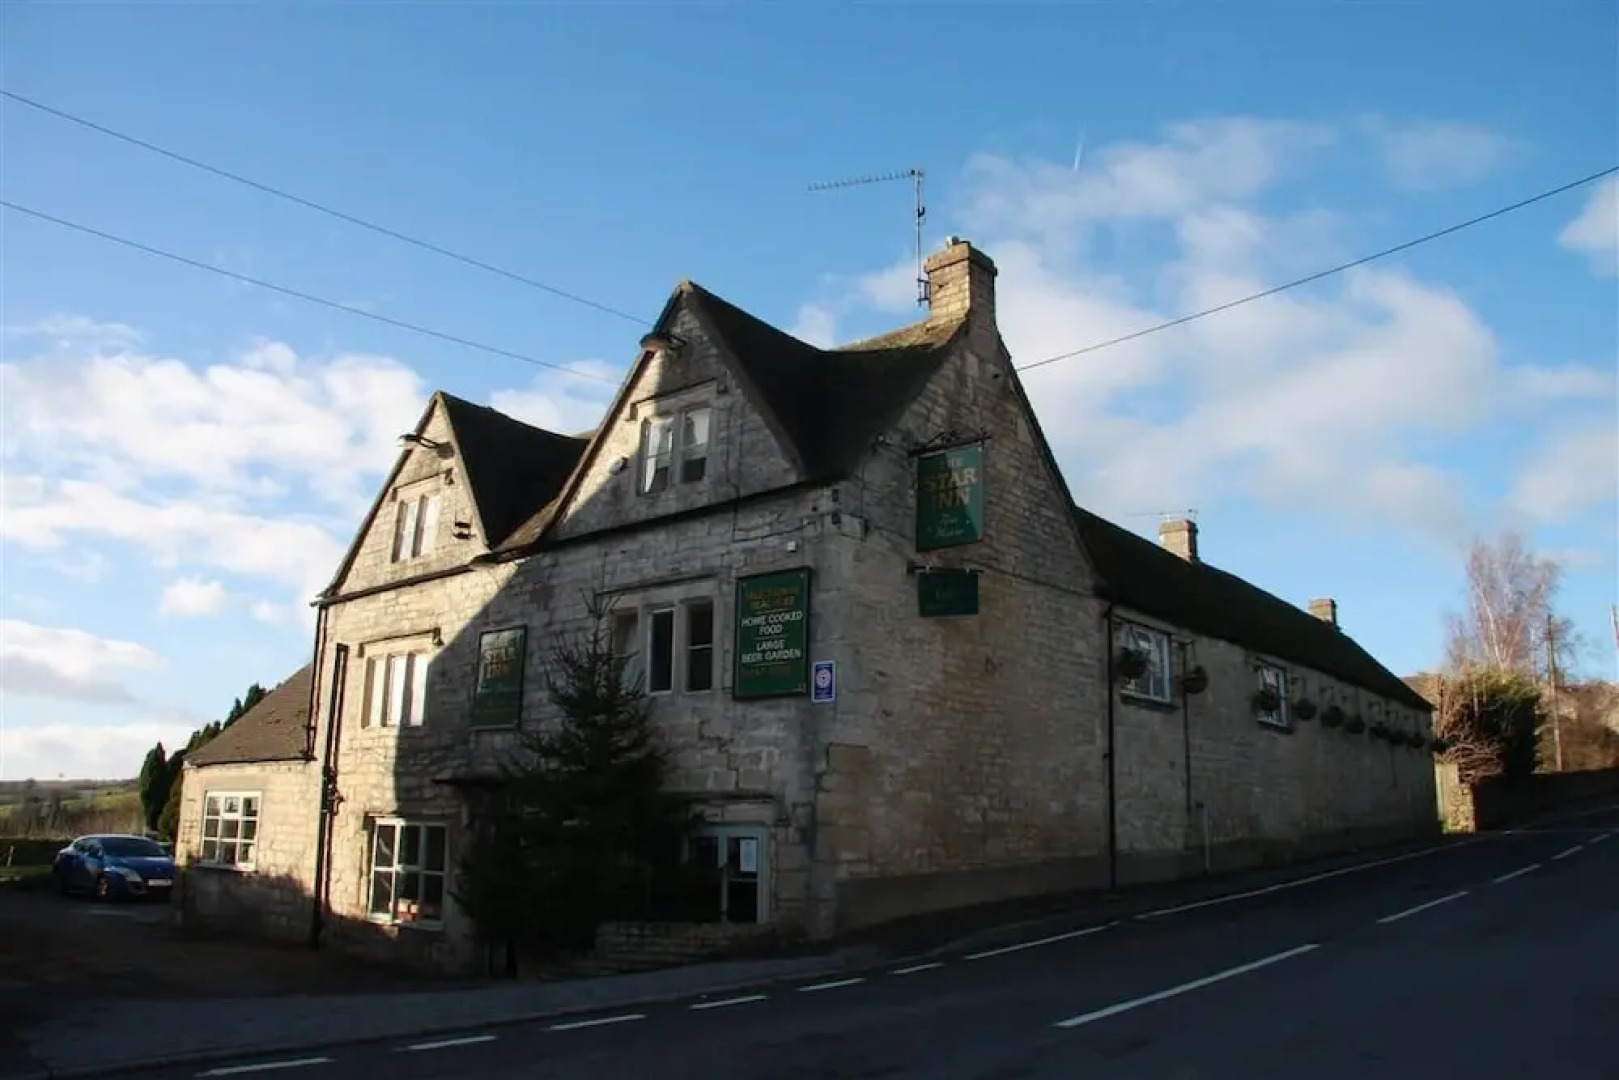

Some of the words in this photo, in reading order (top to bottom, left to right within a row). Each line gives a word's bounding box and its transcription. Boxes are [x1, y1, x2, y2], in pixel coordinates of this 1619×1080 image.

[921, 466, 978, 492] STAR
[931, 486, 970, 511] INN
[741, 615, 767, 628] HOME
[768, 610, 803, 622] COOKED
[758, 624, 783, 635] FOOD
[756, 639, 785, 652] LARGE
[741, 652, 763, 663] BEER
[764, 648, 802, 660] GARDEN
